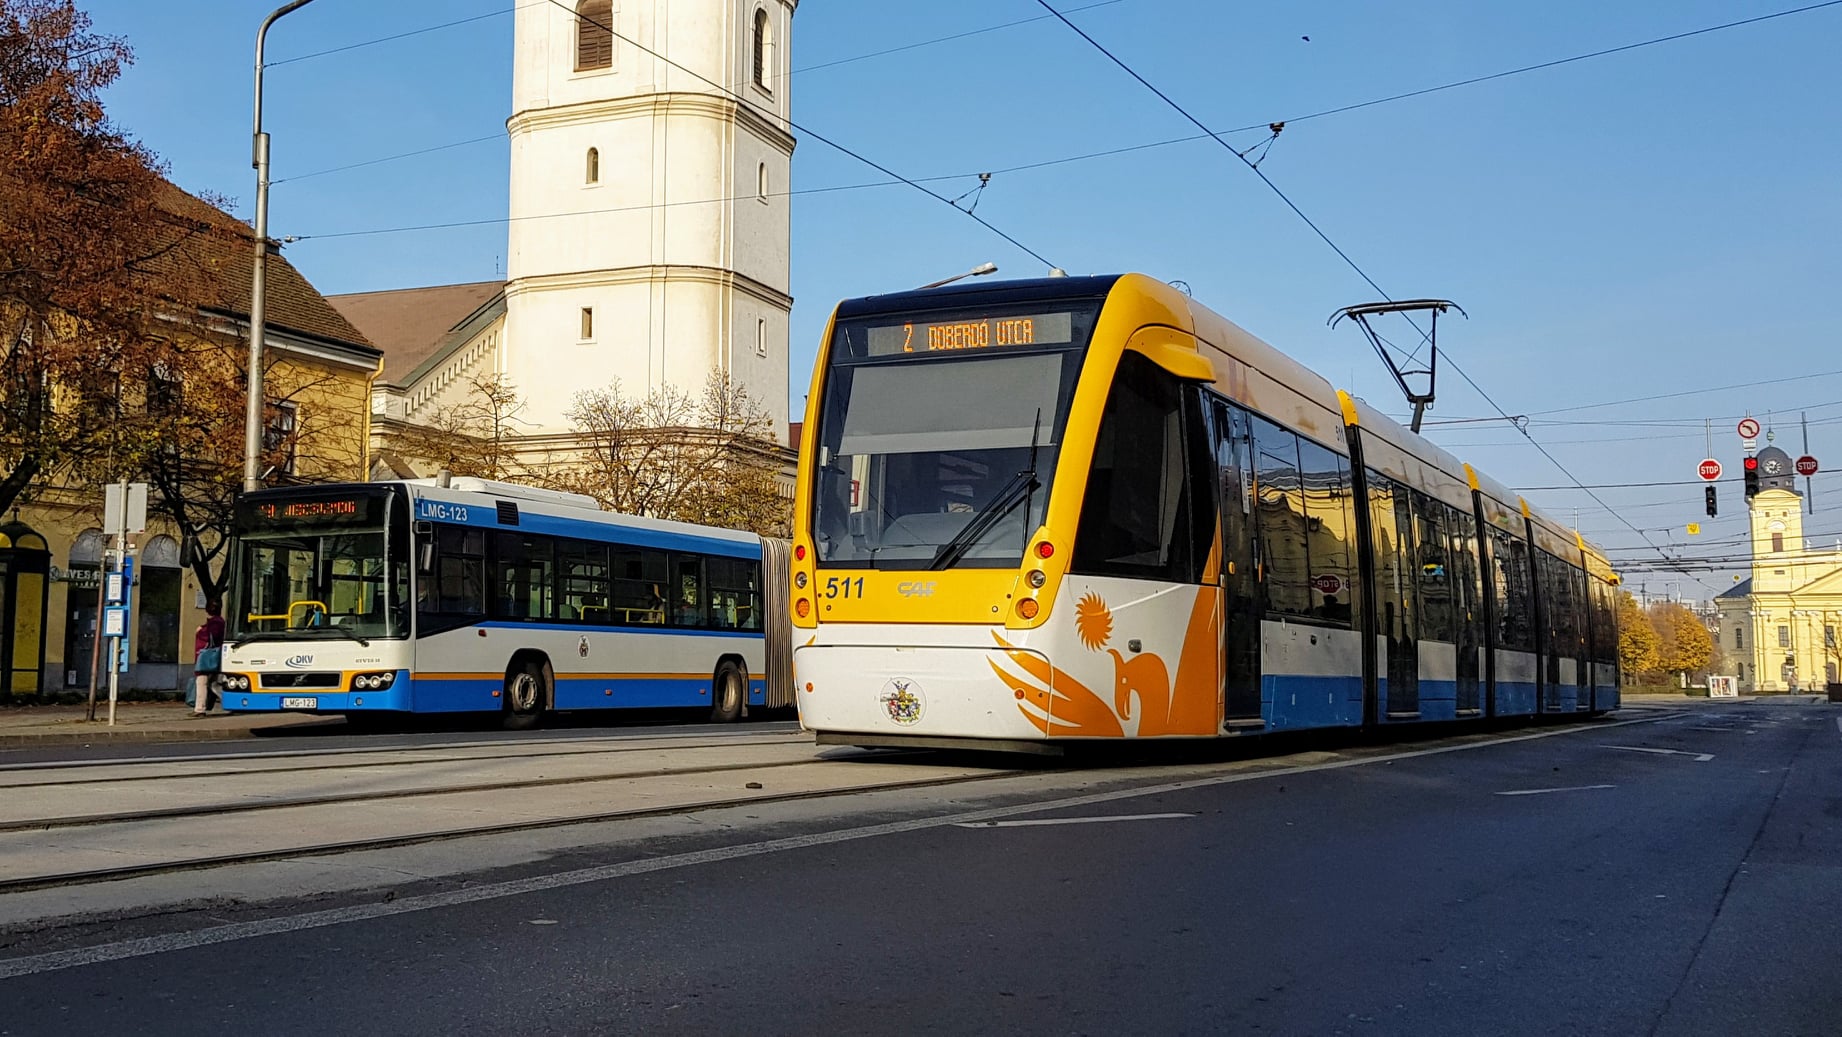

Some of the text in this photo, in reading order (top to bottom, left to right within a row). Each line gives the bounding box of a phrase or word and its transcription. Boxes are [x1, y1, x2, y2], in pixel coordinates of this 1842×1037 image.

[903, 318, 1033, 352] 2 DOBERDÓ UTCA
[1700, 466, 1719, 475] STOP
[1797, 462, 1816, 470] STOP
[421, 502, 468, 521] LMG-123
[825, 576, 864, 599] 511
[295, 655, 314, 664] DKV
[284, 698, 316, 708] LMG-123
